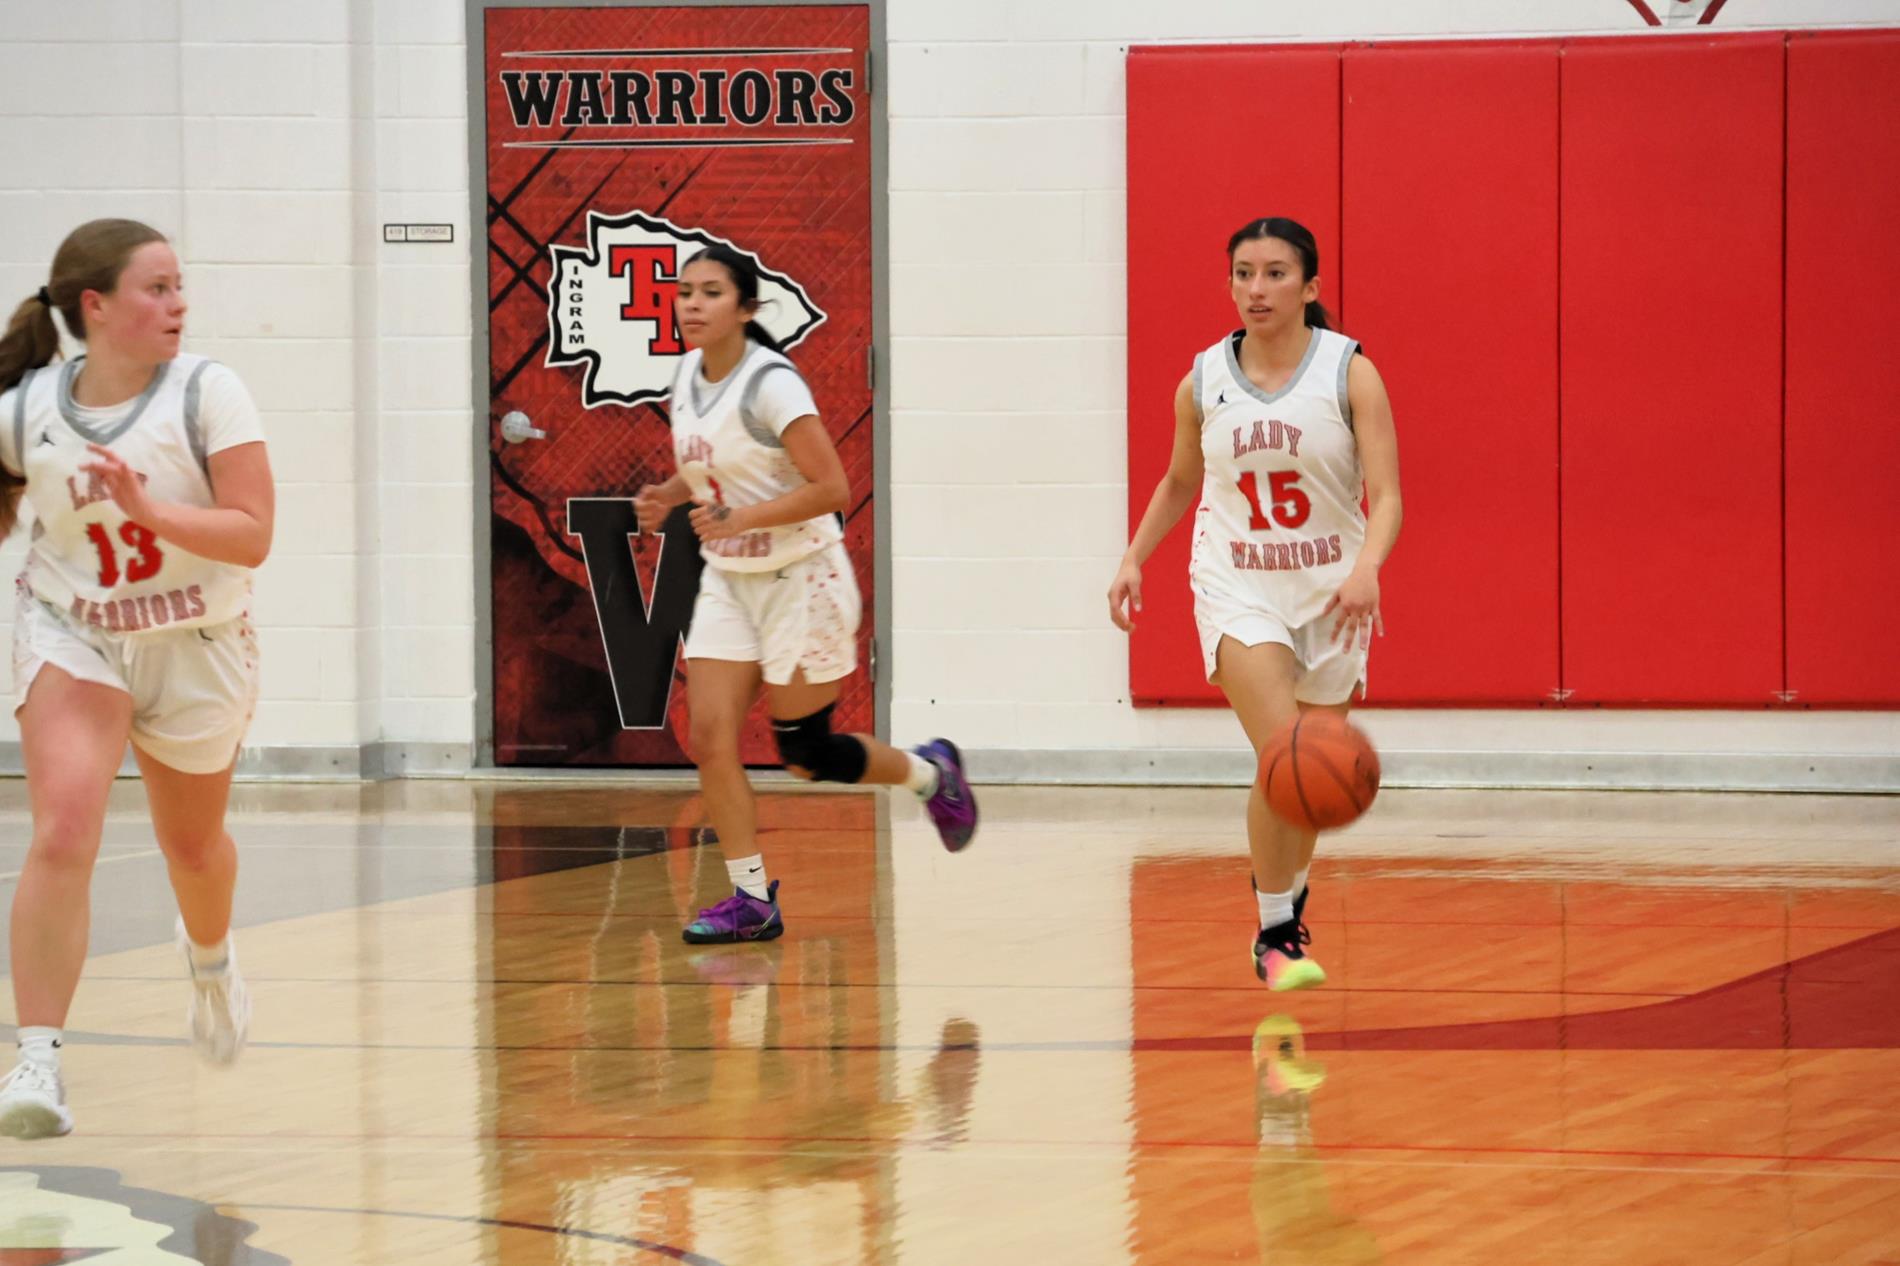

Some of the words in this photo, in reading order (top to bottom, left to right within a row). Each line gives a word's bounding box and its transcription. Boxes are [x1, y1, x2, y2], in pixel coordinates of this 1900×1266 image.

[500, 69, 854, 128] WARRIORS
[569, 265, 585, 344] INGRAM
[1233, 419, 1303, 459] LADY
[67, 471, 148, 510] LA
[1237, 470, 1312, 531] 15
[85, 520, 163, 588] 13
[1230, 534, 1343, 571] WARRIORS
